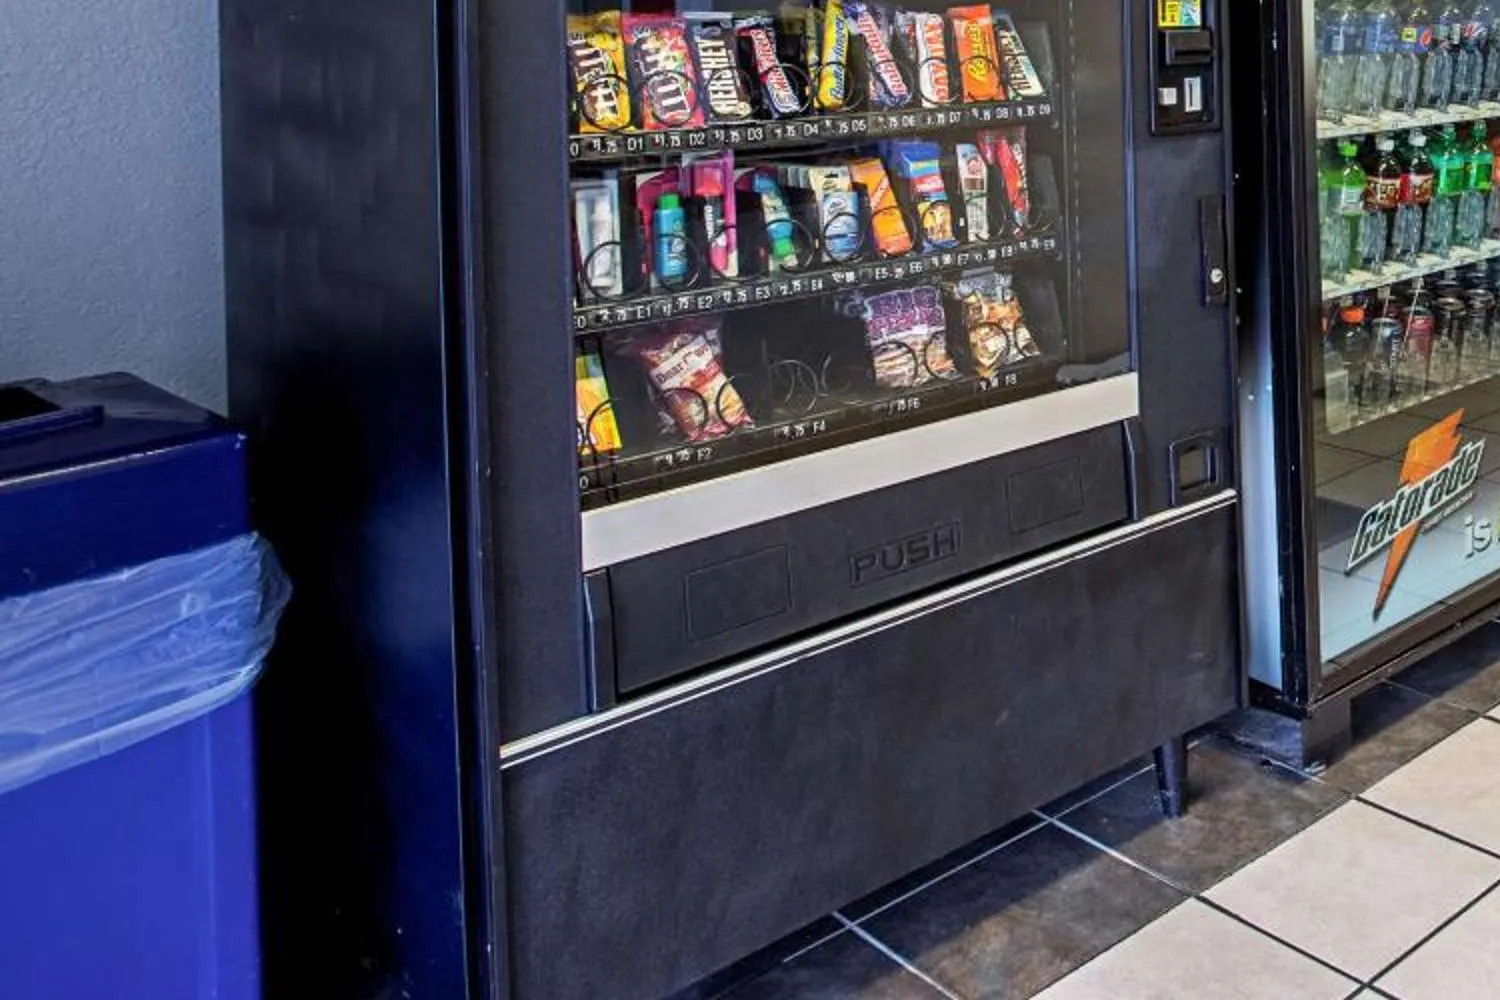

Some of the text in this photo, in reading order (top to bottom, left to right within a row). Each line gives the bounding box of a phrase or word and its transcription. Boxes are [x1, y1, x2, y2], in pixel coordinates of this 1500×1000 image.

[803, 123, 818, 136] D4
[851, 119, 867, 131] D5
[689, 132, 705, 145] D2
[748, 127, 763, 141] D3
[627, 138, 643, 151] D1
[909, 261, 923, 274] E6
[755, 286, 770, 300] E3
[697, 295, 713, 309] E2
[637, 305, 651, 319] E1
[812, 420, 826, 435] F4
[1463, 514, 1493, 559] is
[855, 527, 955, 582] PUSH
